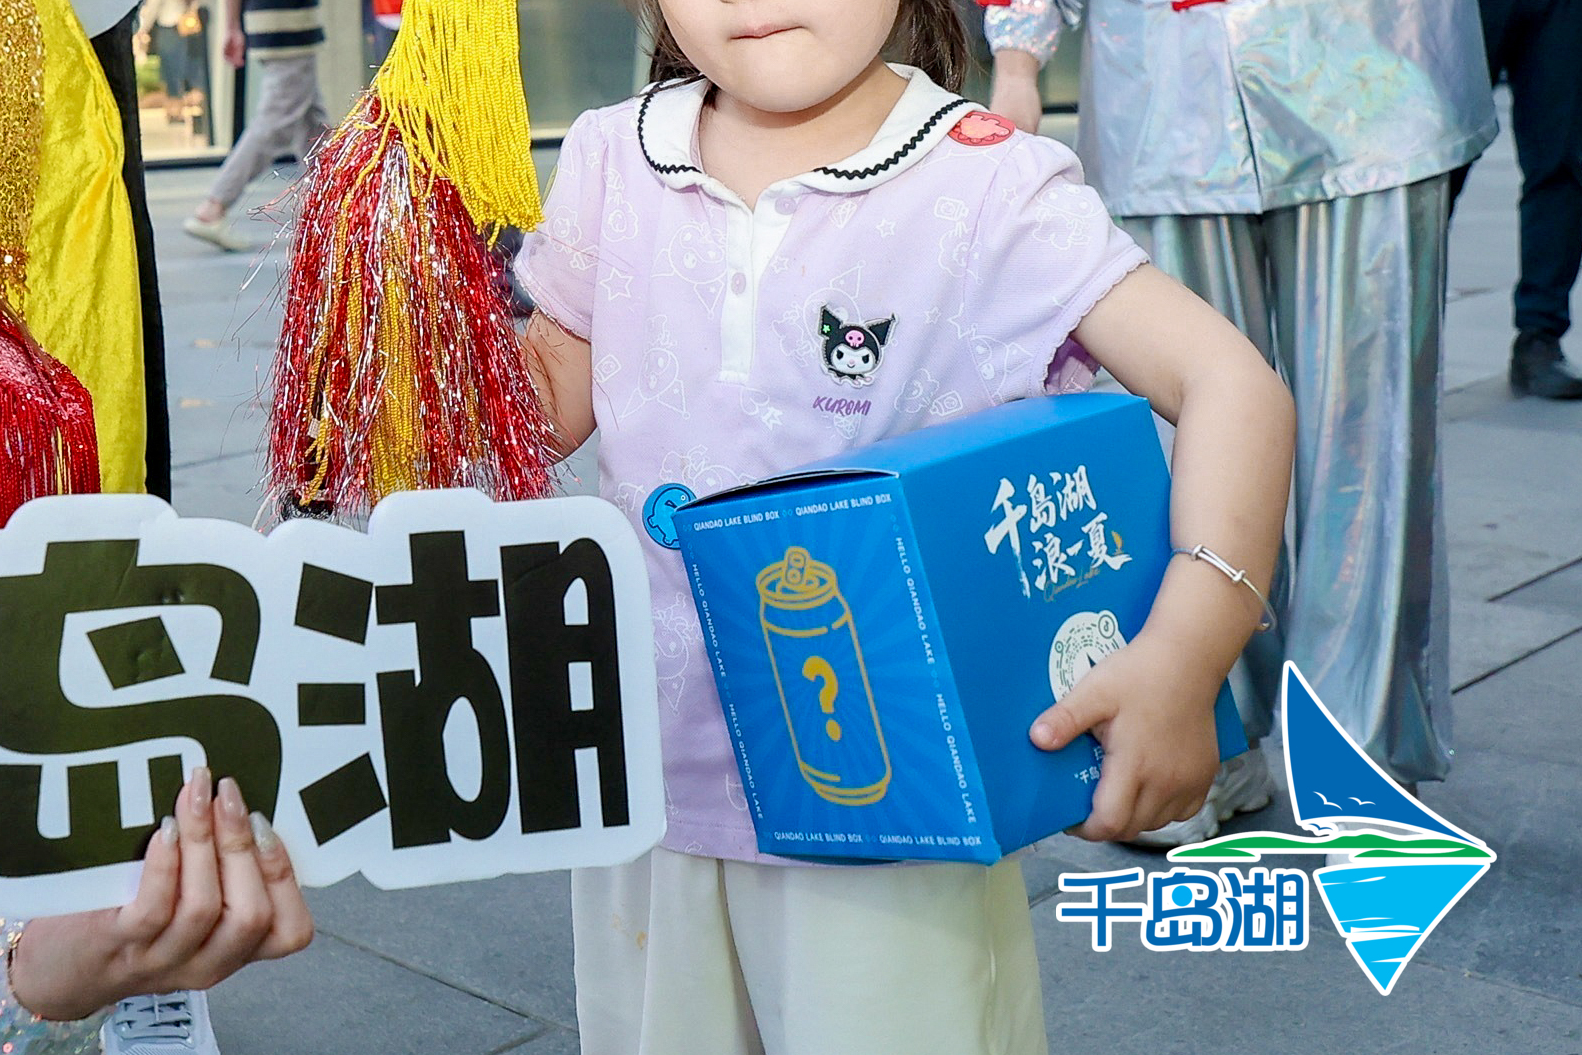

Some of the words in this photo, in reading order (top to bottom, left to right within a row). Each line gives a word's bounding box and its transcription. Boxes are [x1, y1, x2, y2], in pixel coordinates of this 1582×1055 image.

[812, 396, 872, 417] KUROMI
[693, 517, 723, 531] QIANDAO
[724, 516, 742, 527] LAKE
[743, 513, 763, 524] BLIND
[765, 510, 780, 521] BOX
[795, 502, 828, 517] QIANDAO
[829, 500, 849, 511] LAKE
[851, 496, 874, 508] BLIND
[875, 493, 892, 504] BOX
[1032, 512, 1133, 591] 浪一夏
[692, 563, 705, 598] HELLO
[702, 600, 719, 648] QIANDAO
[715, 651, 727, 678] LAKE
[895, 536, 911, 574] HELLO
[906, 577, 926, 631] QIANDAO
[921, 634, 935, 665] LAKE
[802, 655, 843, 742] ?
[729, 703, 742, 738] HELLO
[738, 740, 755, 789] QIANDAO
[752, 792, 764, 820] LAKE
[936, 693, 952, 732] HELLO
[946, 735, 967, 789] QIANDAO
[961, 792, 977, 824] LAKE
[774, 831, 805, 842] QIANDAO
[806, 832, 824, 842] LAKE
[825, 832, 847, 843] BLIND
[848, 833, 864, 843] BOX
[879, 834, 913, 845] QIANDAO
[915, 835, 935, 846] LAKE
[936, 835, 961, 846] BLIND
[962, 836, 982, 846] BOX
